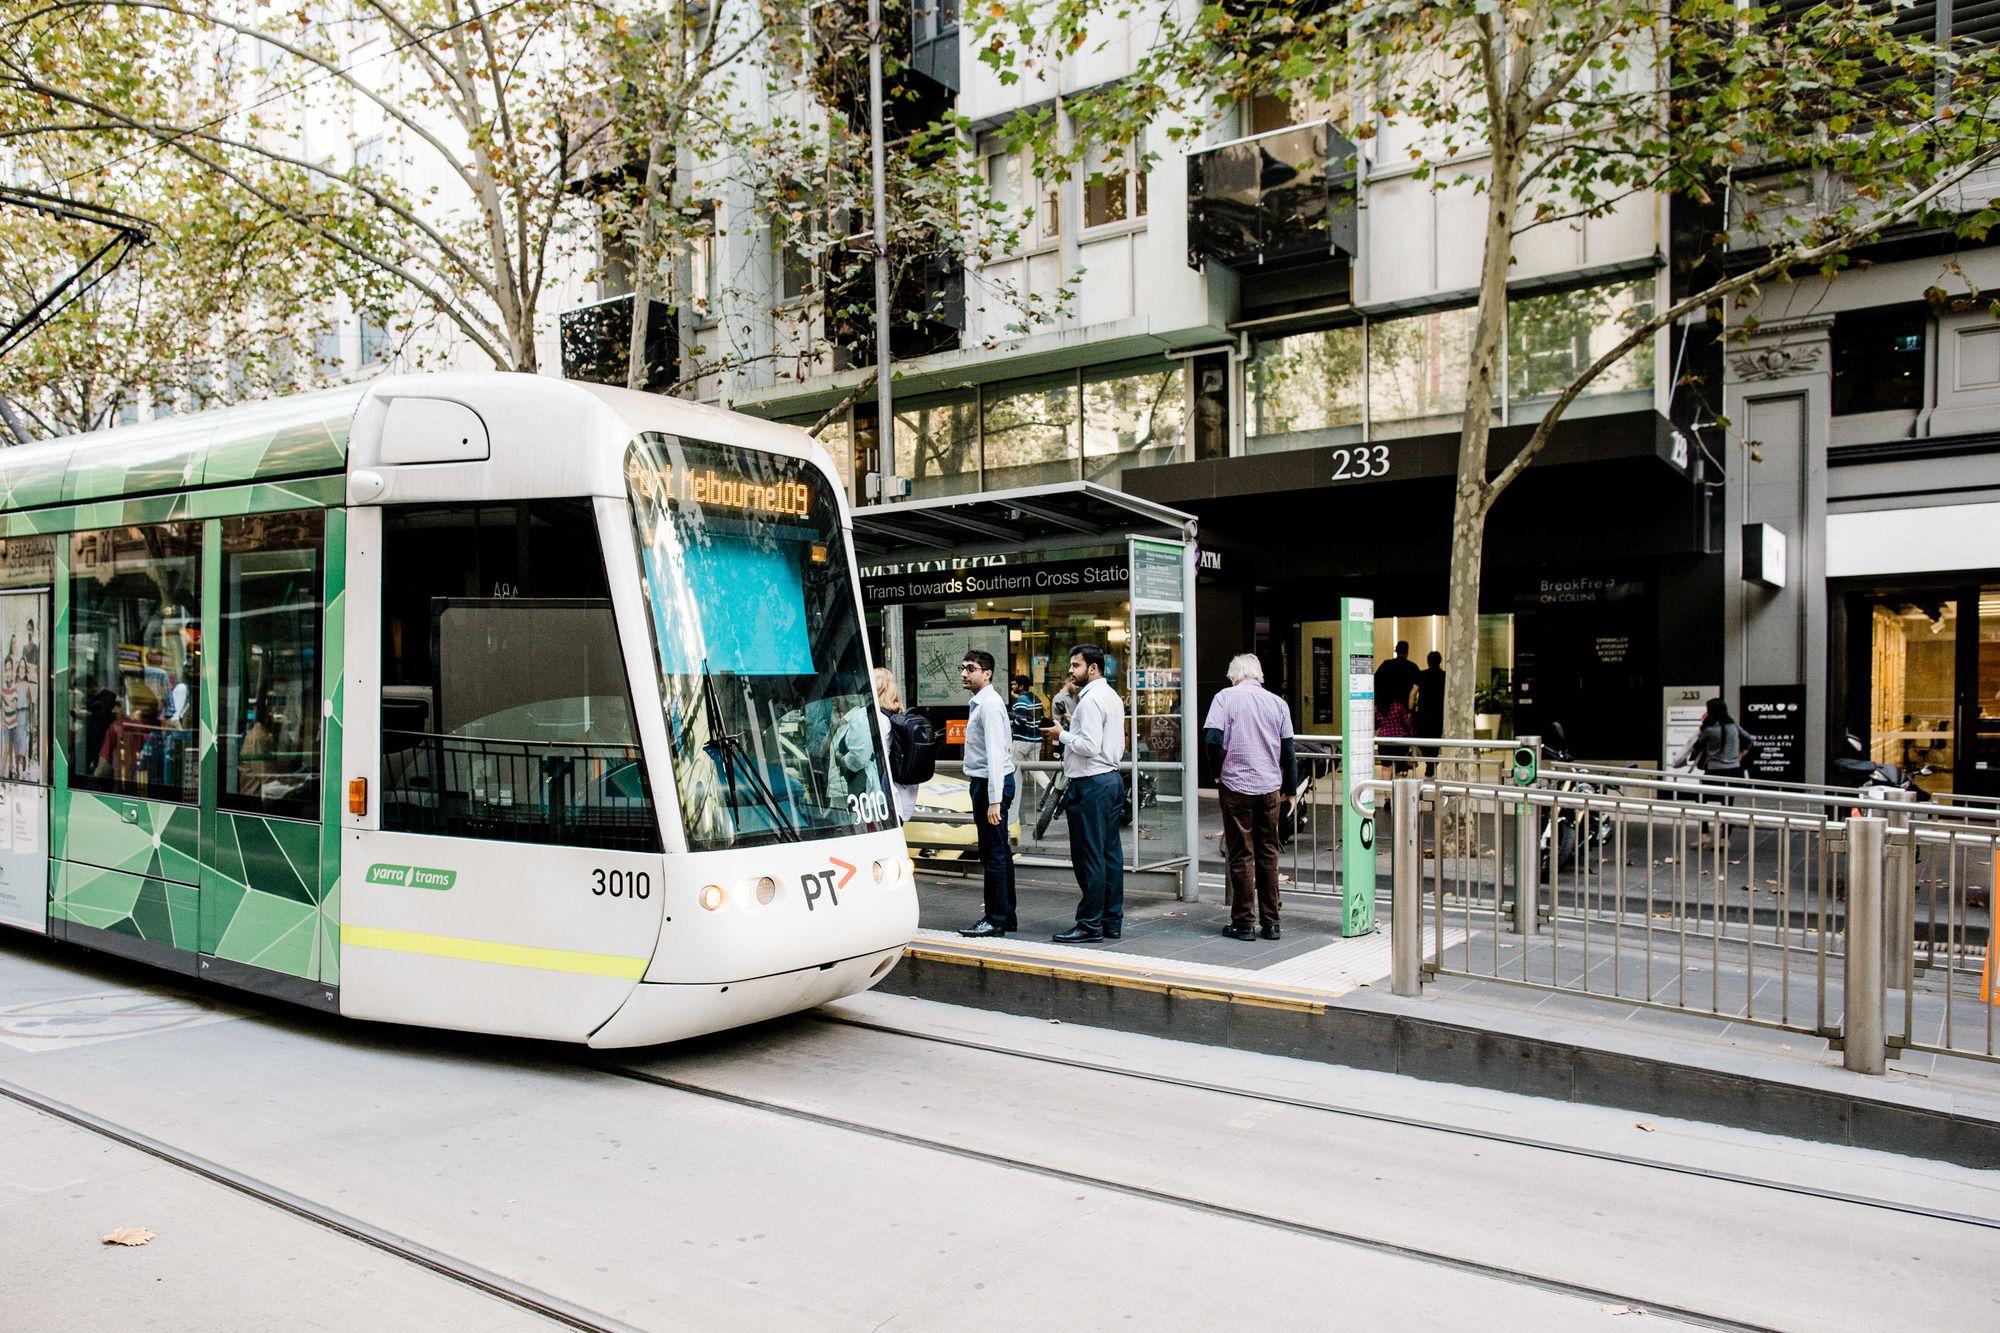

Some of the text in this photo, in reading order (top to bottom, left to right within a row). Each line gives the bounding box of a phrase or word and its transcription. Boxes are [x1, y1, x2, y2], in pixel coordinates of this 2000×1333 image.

[1331, 445, 1391, 480] 233
[1200, 550, 1222, 570] ATM
[866, 584, 905, 600] Trams
[909, 578, 963, 596] towards
[966, 574, 1031, 592] Southern
[1035, 571, 1079, 587] Cross
[1083, 565, 1129, 584] Statio
[1681, 690, 1700, 700] 233
[1747, 703, 1774, 712] OPSM
[847, 790, 889, 825] 3010
[372, 866, 449, 886] yarra trams
[591, 868, 651, 900] 3010
